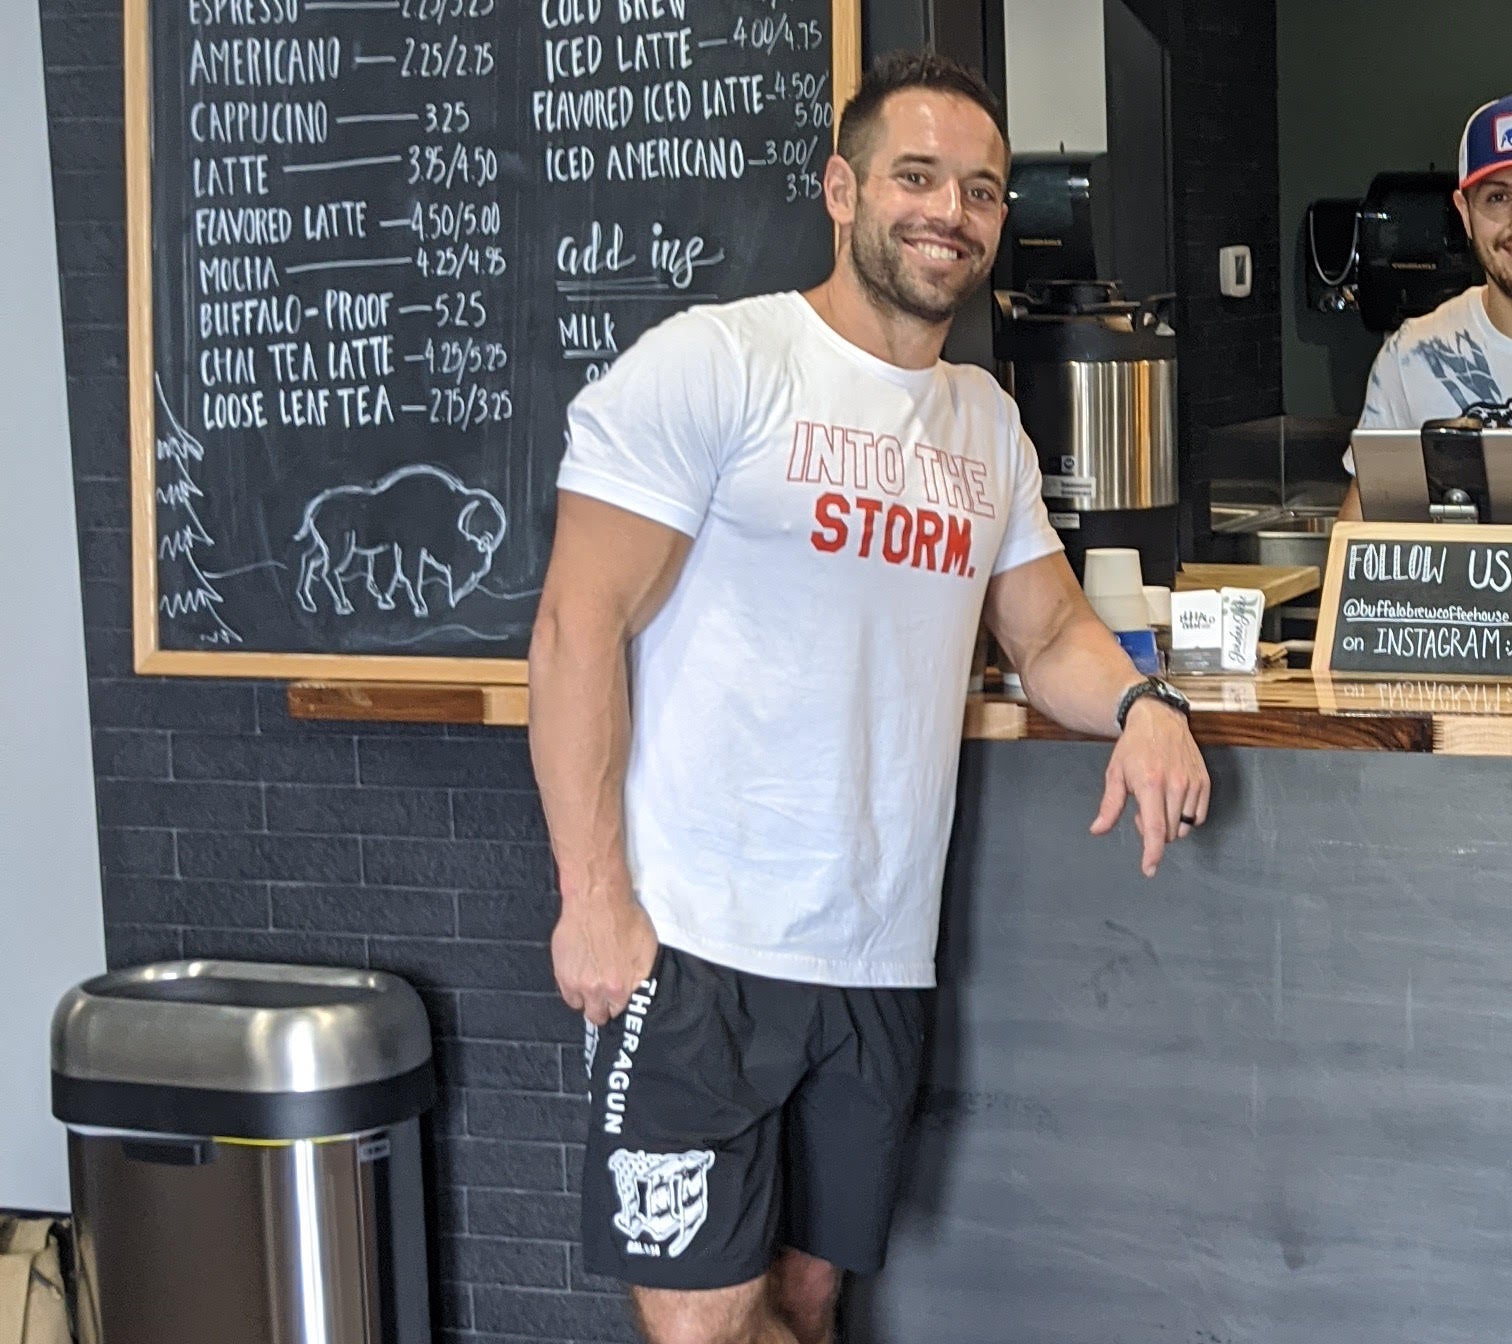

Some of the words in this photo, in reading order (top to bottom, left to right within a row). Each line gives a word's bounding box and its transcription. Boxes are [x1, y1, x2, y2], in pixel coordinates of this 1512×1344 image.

[190, 36, 341, 87] AMERICANO
[545, 34, 602, 83] ICED
[616, 27, 693, 72] LATTE
[190, 99, 329, 144] CAPPUCINO
[533, 84, 634, 133] FLAVORED
[644, 79, 692, 124] ICED
[702, 74, 764, 120] LATTE
[193, 154, 269, 198] LATTE
[545, 144, 596, 182] ICED
[607, 137, 745, 181] AMERICANO
[195, 207, 293, 247] FLAVORED
[304, 201, 367, 241] LATTE
[557, 220, 637, 276] add
[199, 256, 280, 295] MOCHA
[558, 312, 618, 353] MILK
[200, 346, 256, 387] CHAI
[267, 341, 319, 383] TEA
[328, 334, 396, 380] LATTE
[203, 390, 268, 430] LOOSE
[279, 388, 330, 427] LEAF
[336, 384, 396, 429] TEA
[787, 421, 905, 497] INTO
[914, 442, 996, 520] THE
[810, 491, 976, 578] STORM.
[1348, 542, 1447, 585] FOLLOW
[1468, 549, 1512, 593] US
[1343, 598, 1511, 624] @buffalobrewcoffeehouse
[1342, 636, 1365, 652] on
[1373, 627, 1501, 660] INSTAGRAM
